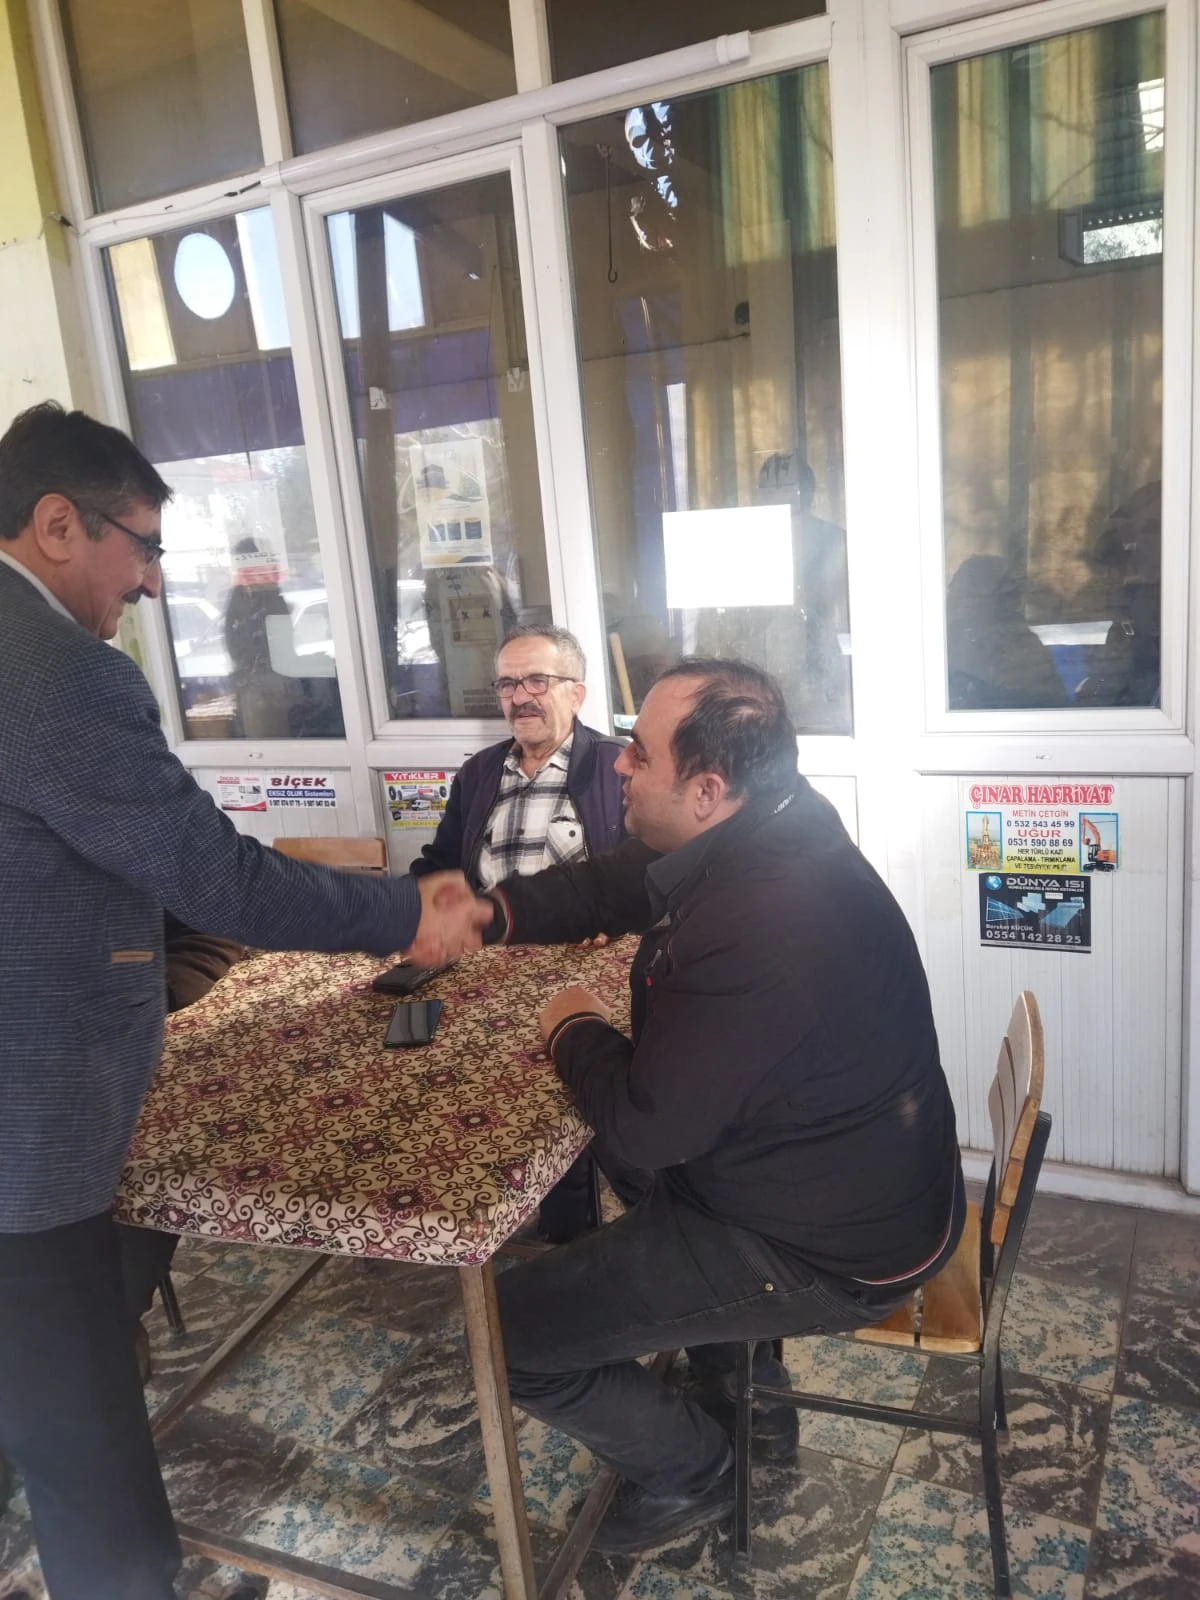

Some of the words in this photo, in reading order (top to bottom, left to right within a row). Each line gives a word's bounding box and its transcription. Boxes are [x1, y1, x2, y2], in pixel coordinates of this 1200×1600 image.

[270, 775, 328, 788] BİÇEK
[970, 784, 1024, 808] ÇINAR
[1012, 809, 1037, 818] METİN
[1014, 820, 1030, 828] 532
[1032, 820, 1048, 828] 543
[1017, 828, 1062, 838] UĞUR
[1007, 838, 1028, 846] 0531
[1031, 838, 1047, 847] 590
[1049, 839, 1060, 847] 88
[1062, 839, 1073, 847] 69
[1031, 847, 1049, 855] TÜRLÜ
[1006, 876, 1061, 888] DÜNYA
[1065, 880, 1084, 889] ISI
[986, 930, 1016, 939] 0554
[1020, 932, 1042, 942] 142
[1046, 933, 1062, 943] 28
[1066, 935, 1081, 944] 25
